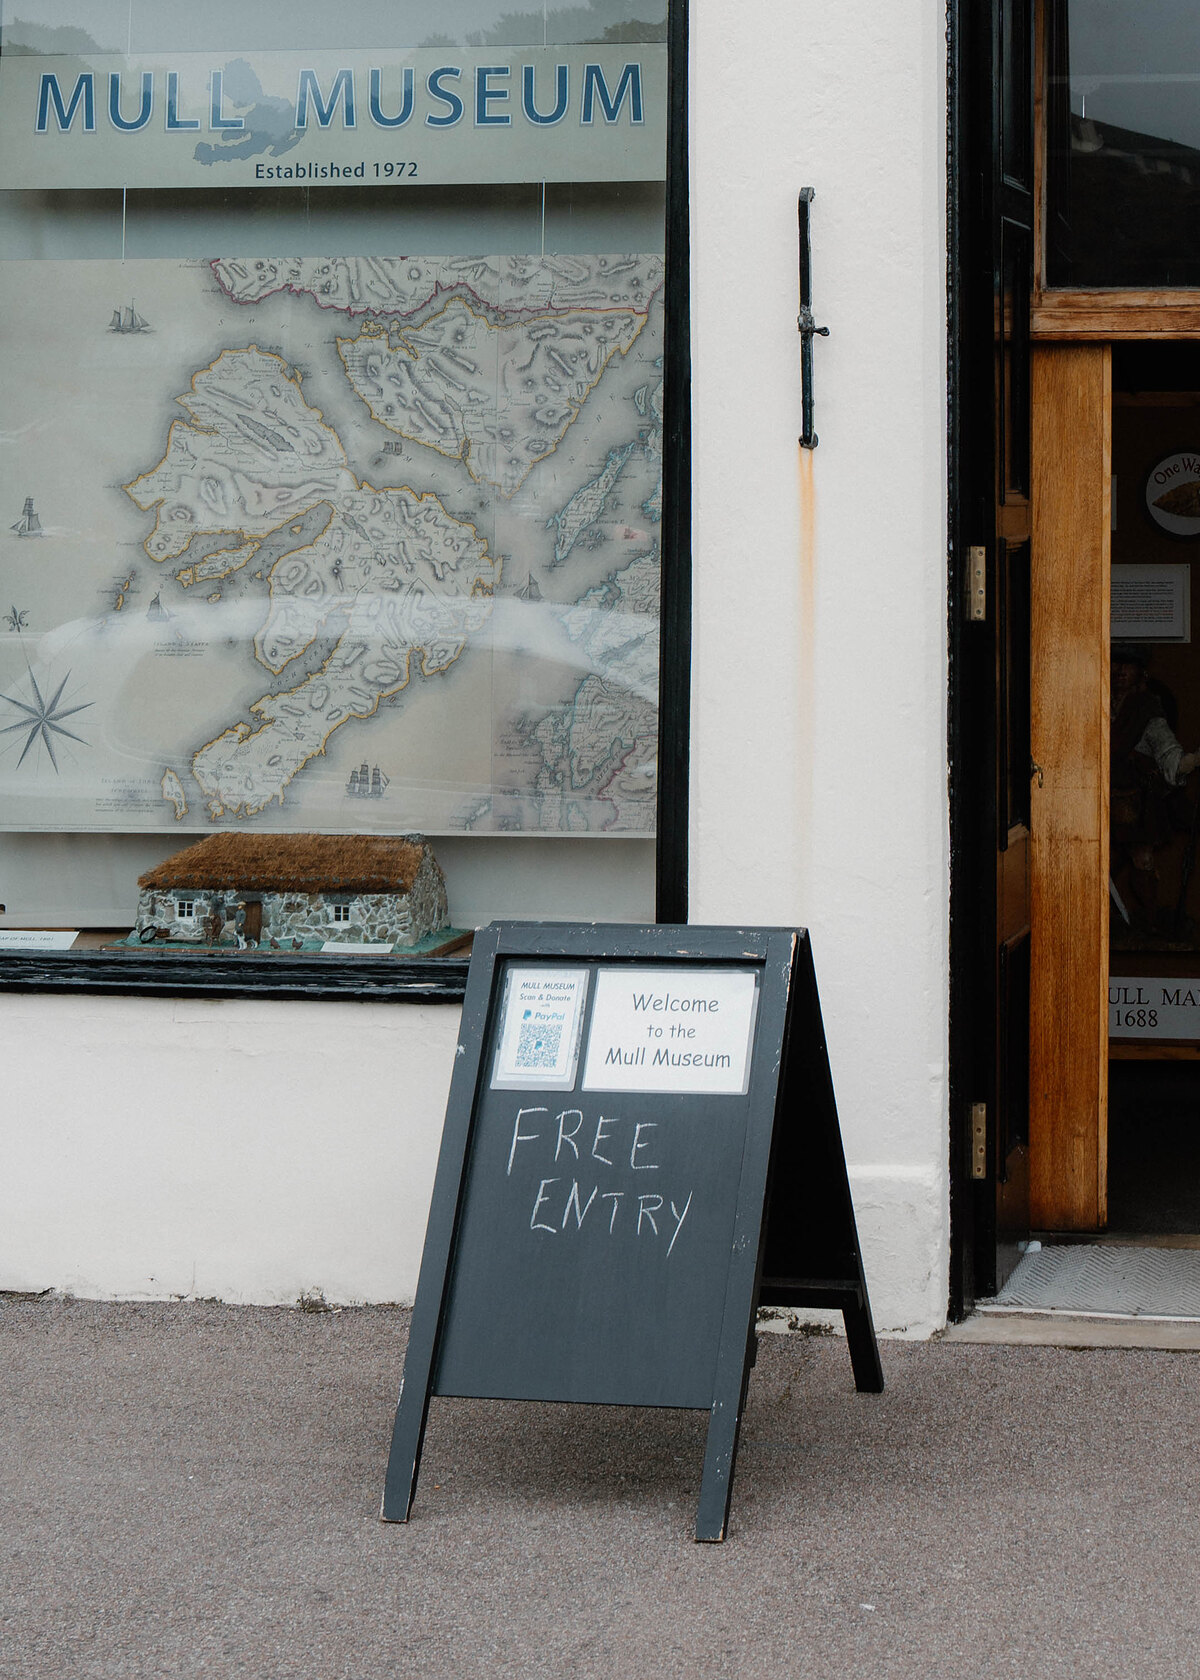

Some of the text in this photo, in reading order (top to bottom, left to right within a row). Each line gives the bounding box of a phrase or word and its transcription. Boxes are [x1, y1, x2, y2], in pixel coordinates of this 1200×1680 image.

[34, 61, 646, 134] MULL MUSEUM
[254, 162, 418, 180] Established 1972
[1154, 464, 1180, 485] One
[633, 993, 719, 1012] Welcome
[1109, 988, 1149, 1005] ULL
[535, 1012, 565, 1022] PayPal
[1116, 1009, 1157, 1027] 1688
[647, 1024, 696, 1038] to the
[605, 1047, 730, 1068] Mull Museum
[507, 1107, 659, 1176] FREE
[530, 1177, 693, 1258] ENTRY
